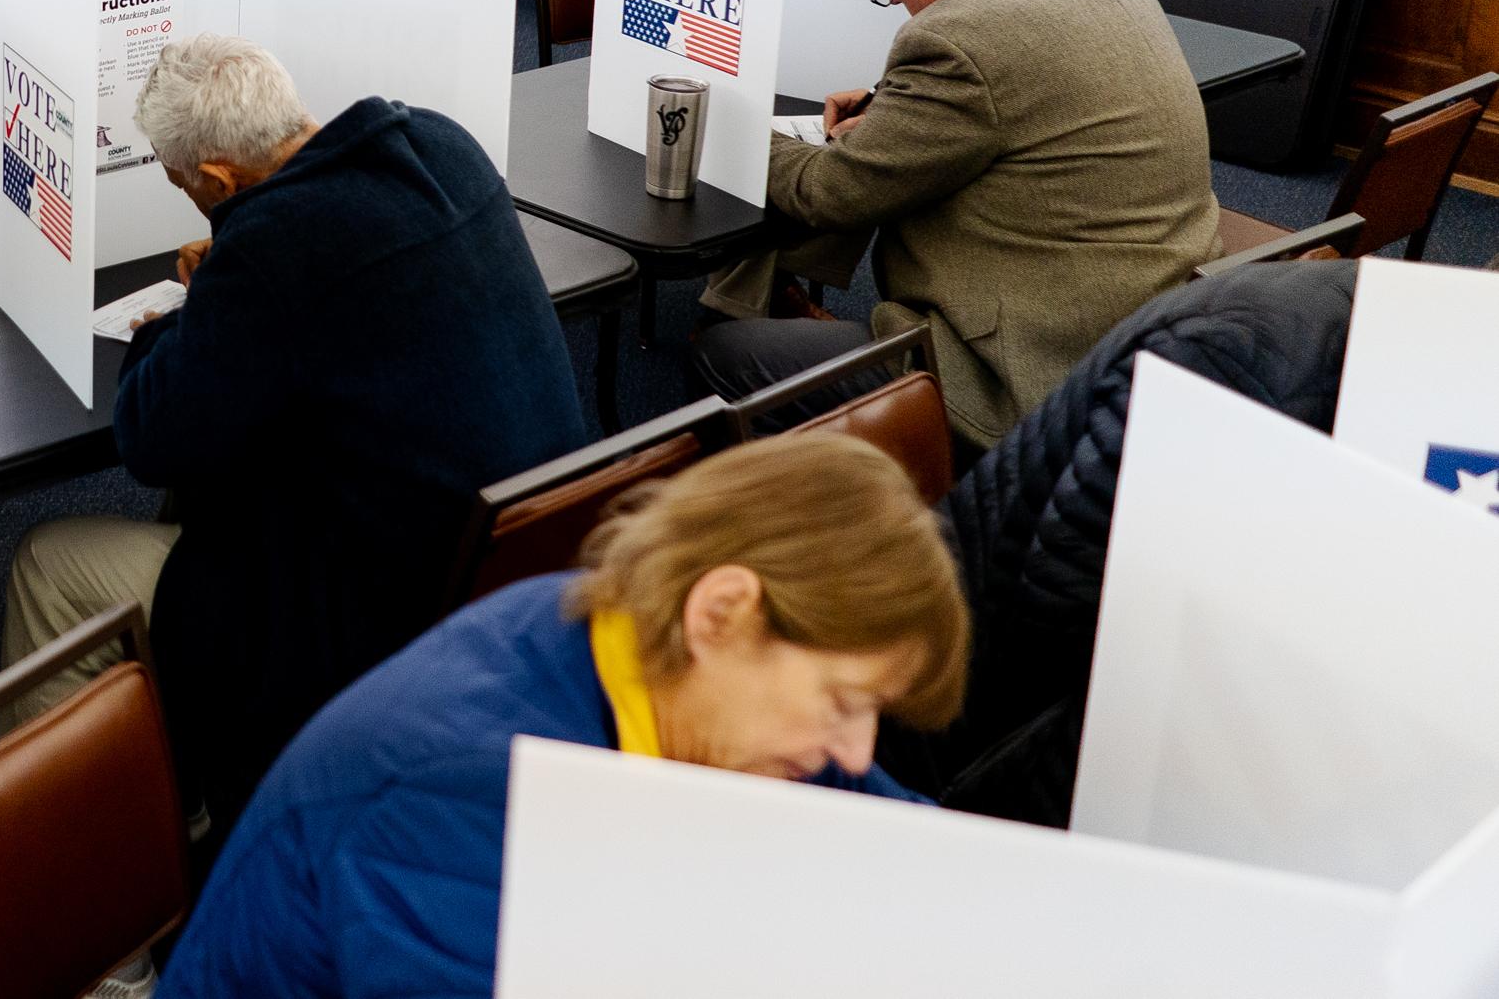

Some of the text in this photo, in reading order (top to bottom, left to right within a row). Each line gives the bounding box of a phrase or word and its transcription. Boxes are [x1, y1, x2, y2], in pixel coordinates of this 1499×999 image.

[118, 10, 149, 21] Marking
[150, 5, 171, 16] Ballot
[126, 24, 157, 36] DO NOT
[5, 57, 56, 132] VOTE
[18, 119, 71, 200] HERE
